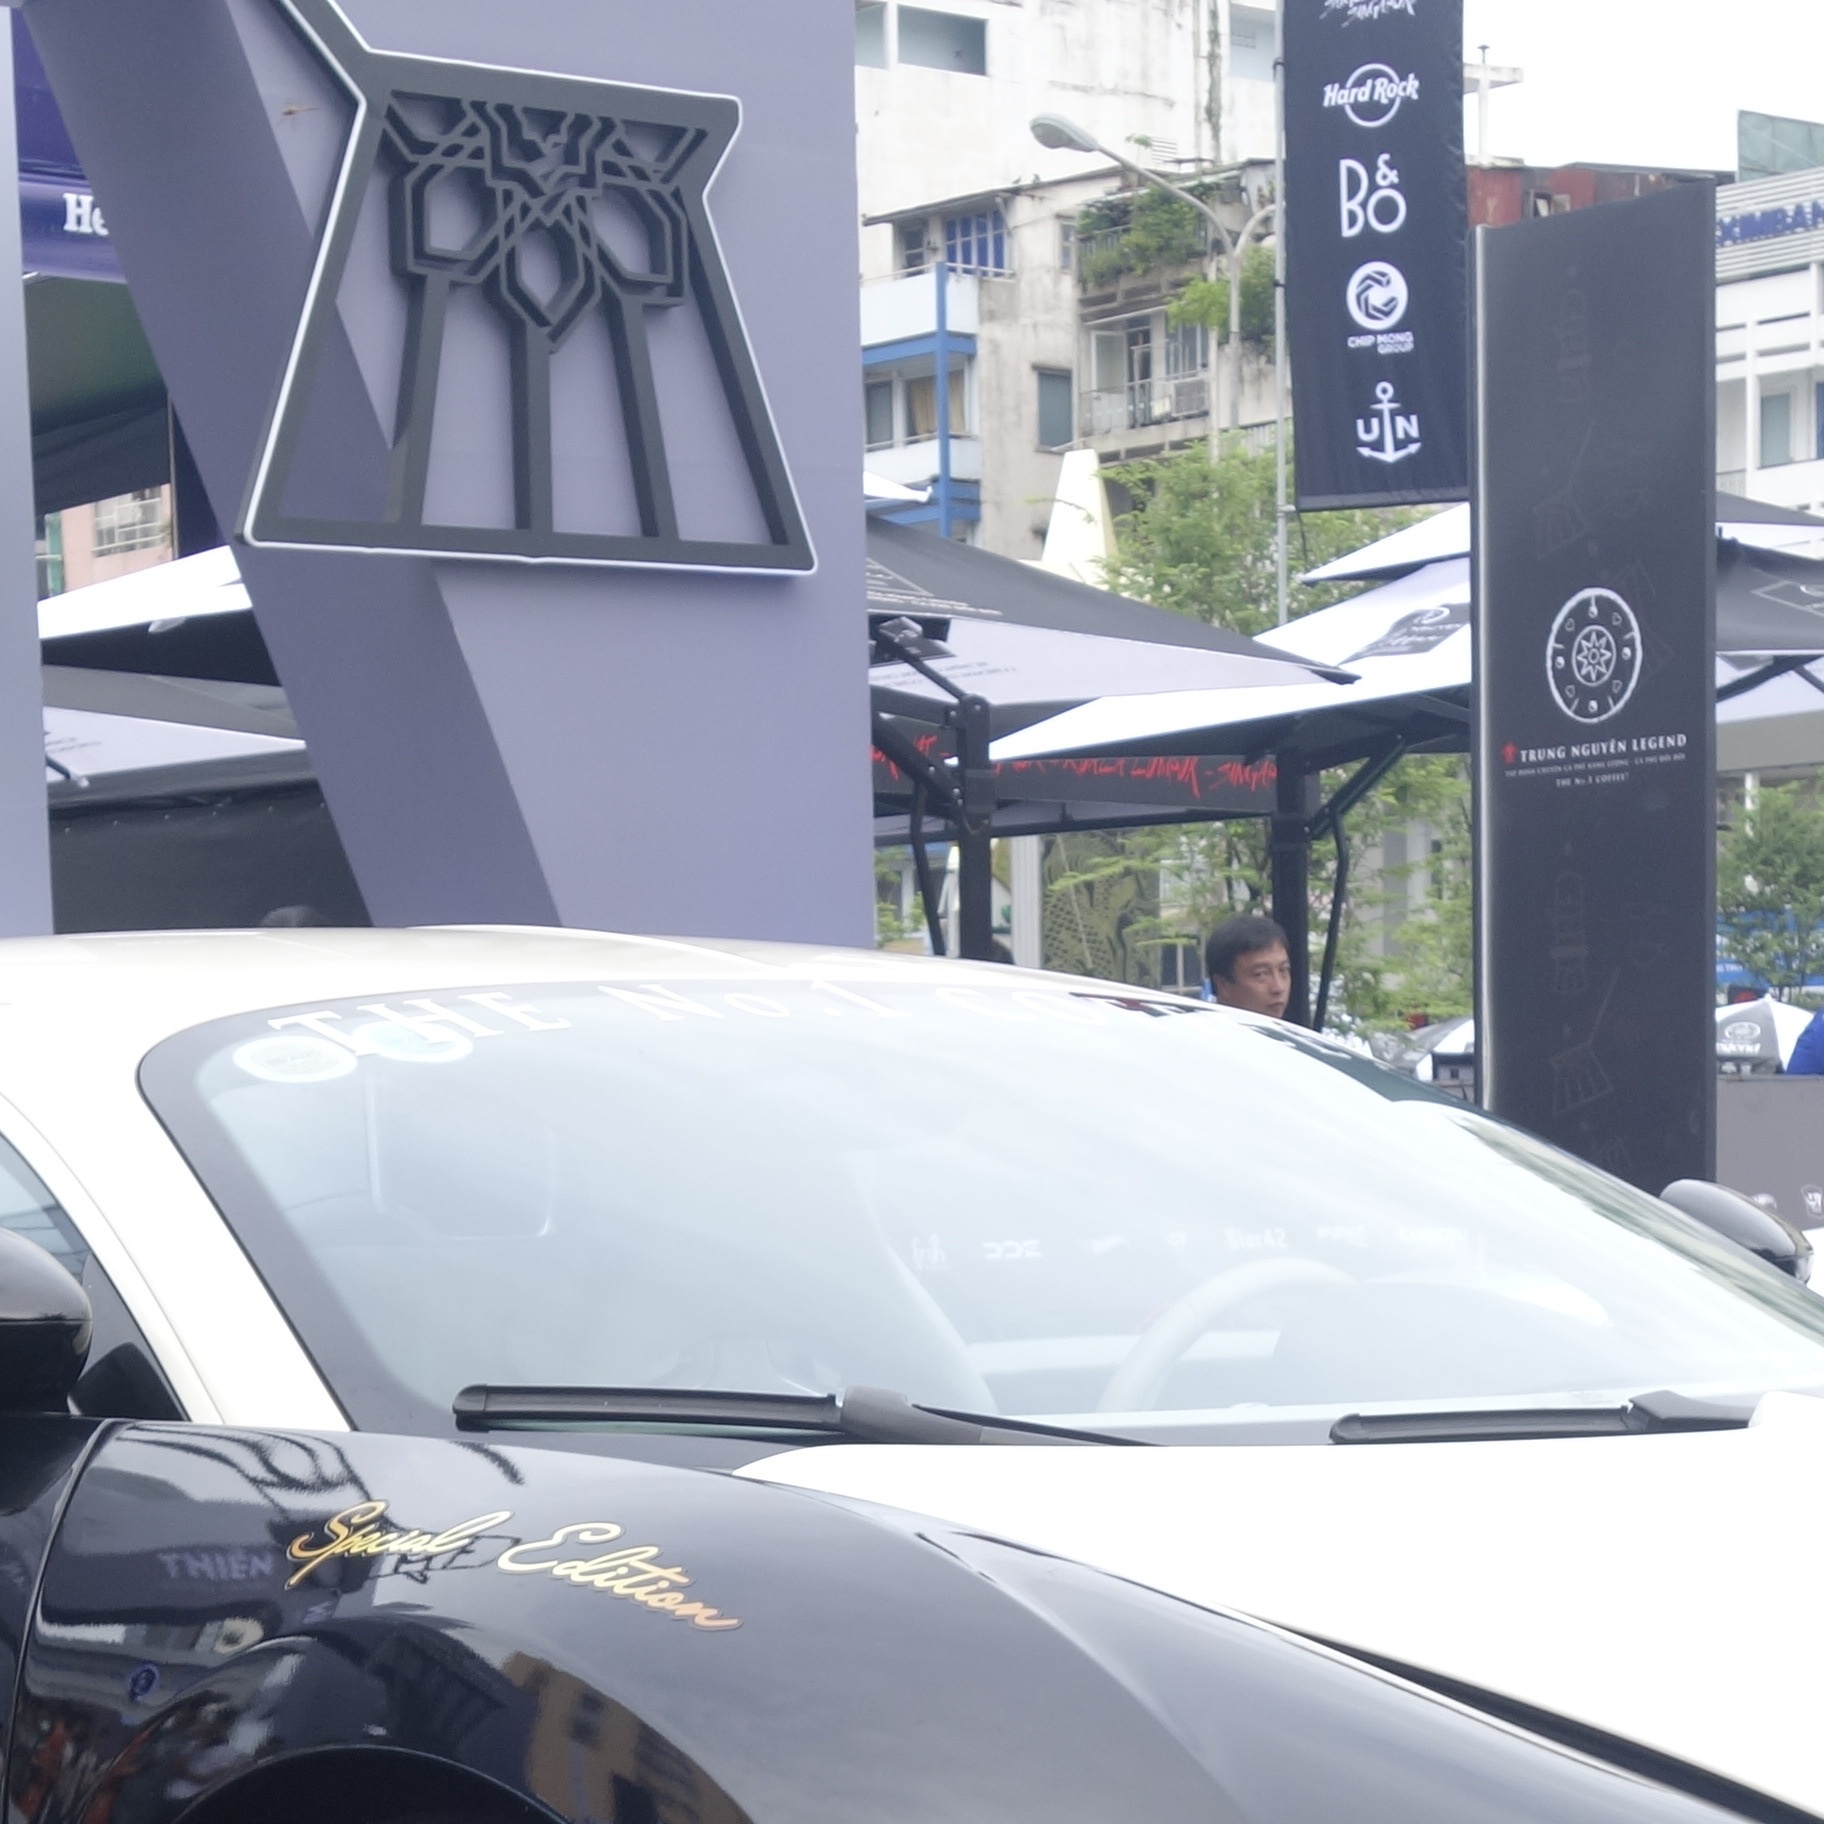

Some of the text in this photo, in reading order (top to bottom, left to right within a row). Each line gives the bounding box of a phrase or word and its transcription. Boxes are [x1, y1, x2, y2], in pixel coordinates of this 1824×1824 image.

[1323, 73, 1419, 107] Hard Rock
[1521, 746, 1566, 763] TRUNG
[1632, 733, 1688, 751] LEGEND
[285, 1500, 742, 1632] Special Edition
